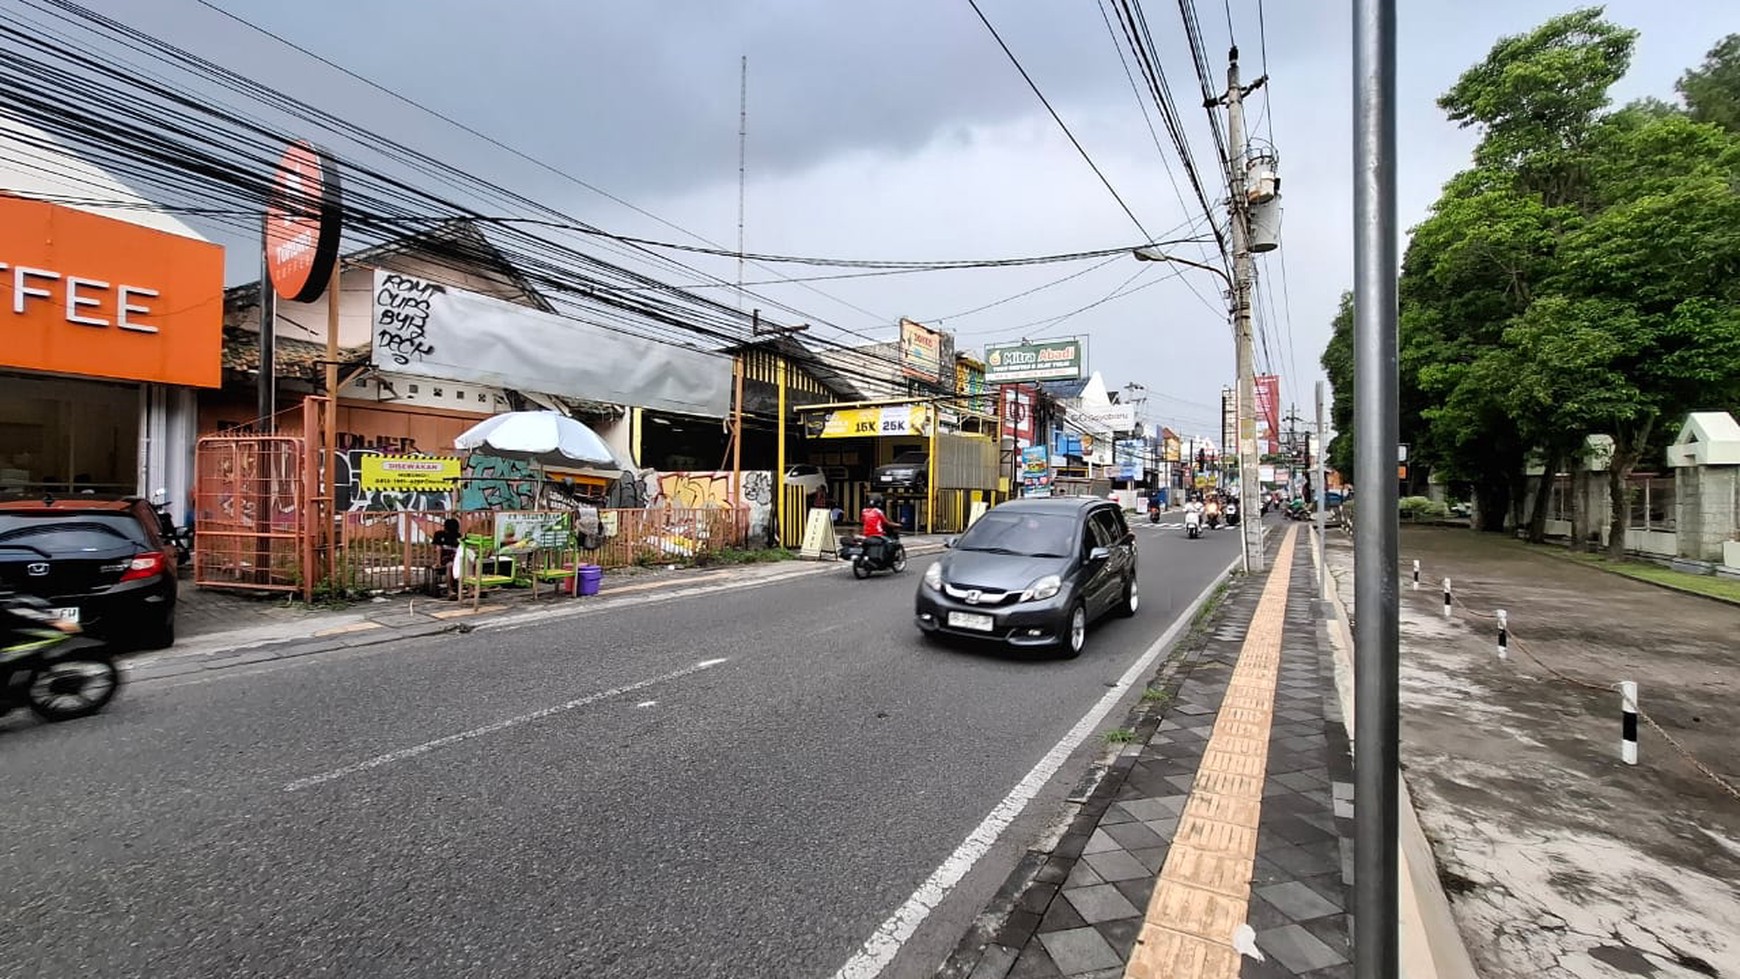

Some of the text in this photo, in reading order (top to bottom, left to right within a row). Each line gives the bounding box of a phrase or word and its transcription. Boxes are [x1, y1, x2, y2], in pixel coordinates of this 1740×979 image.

[0, 262, 160, 333] FEE
[1002, 351, 1037, 366] Mitra
[1038, 346, 1075, 362] Abadi
[388, 463, 438, 471] DISEWAKAN
